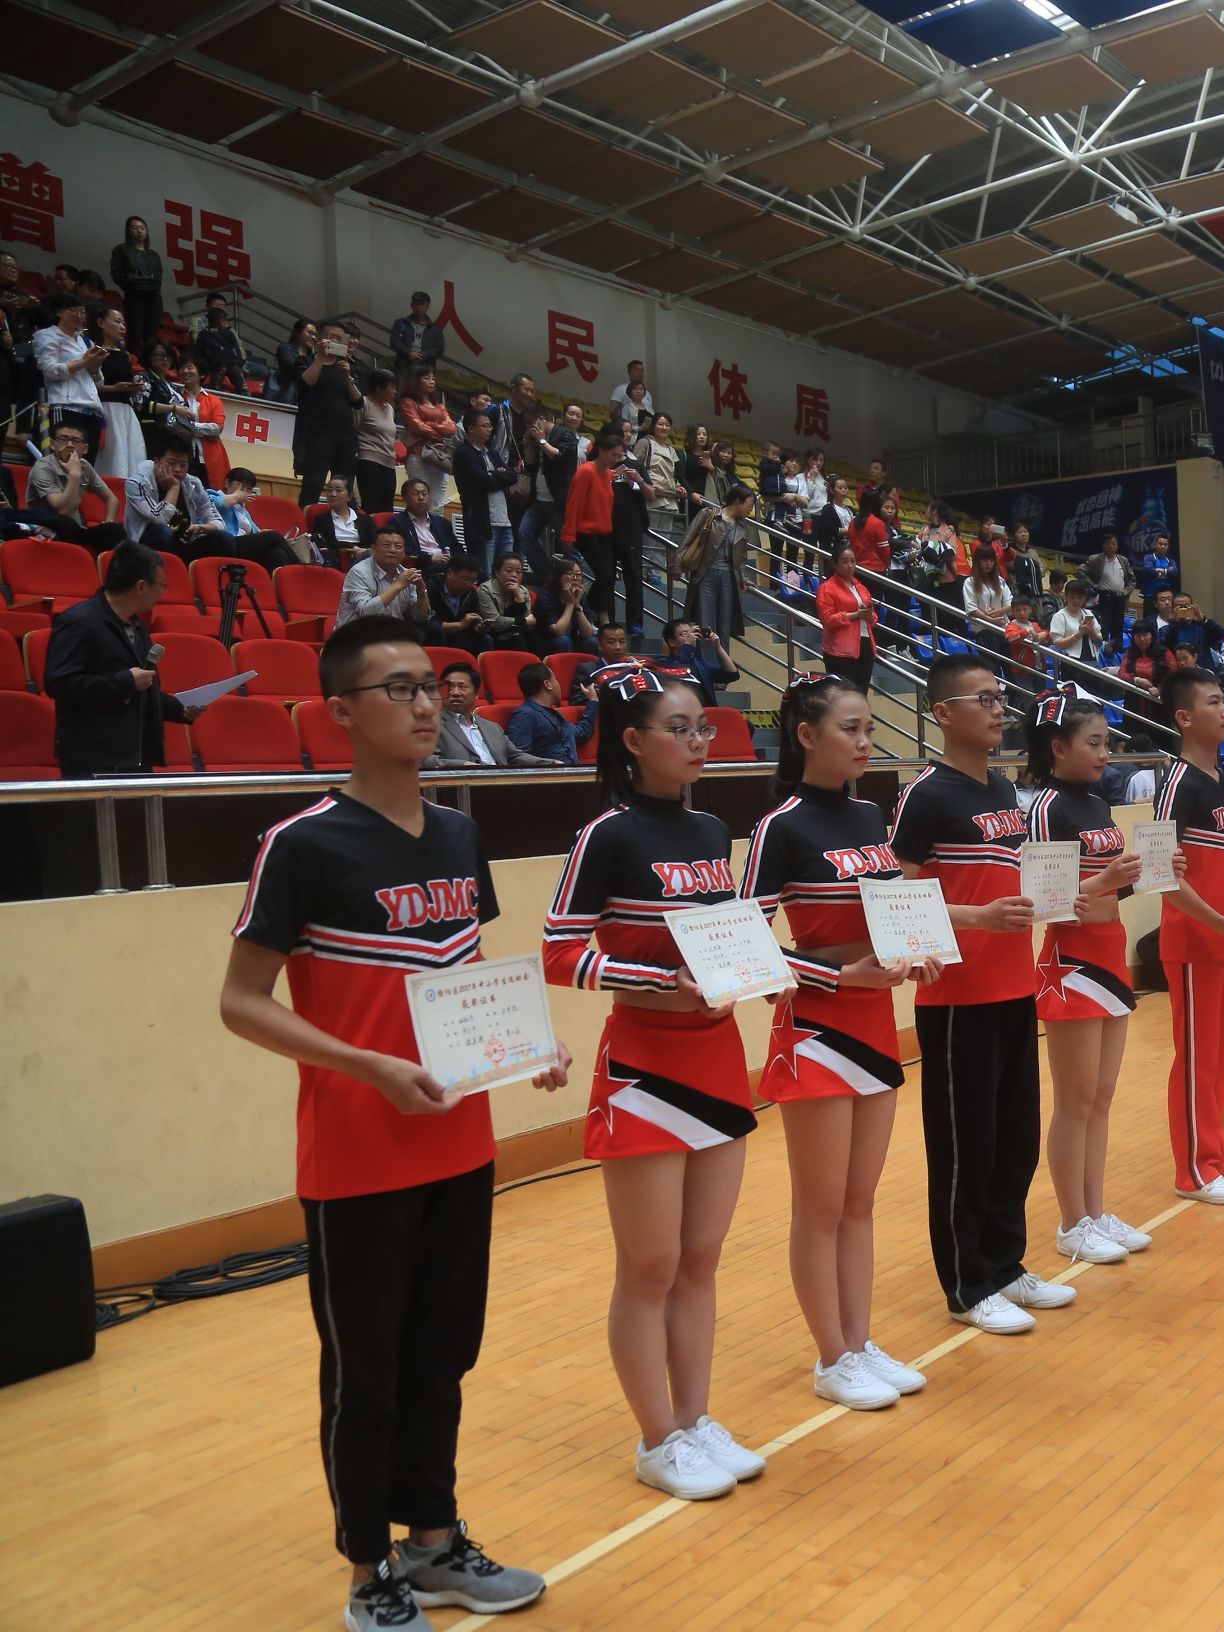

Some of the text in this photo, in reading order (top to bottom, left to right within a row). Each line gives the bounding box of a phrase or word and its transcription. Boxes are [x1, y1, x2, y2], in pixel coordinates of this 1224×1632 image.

[235, 411, 270, 444] 中
[1079, 826, 1125, 856] YDJM
[652, 857, 737, 898] YDJM
[822, 842, 902, 881] YDJM
[375, 876, 480, 932] YDJMC
